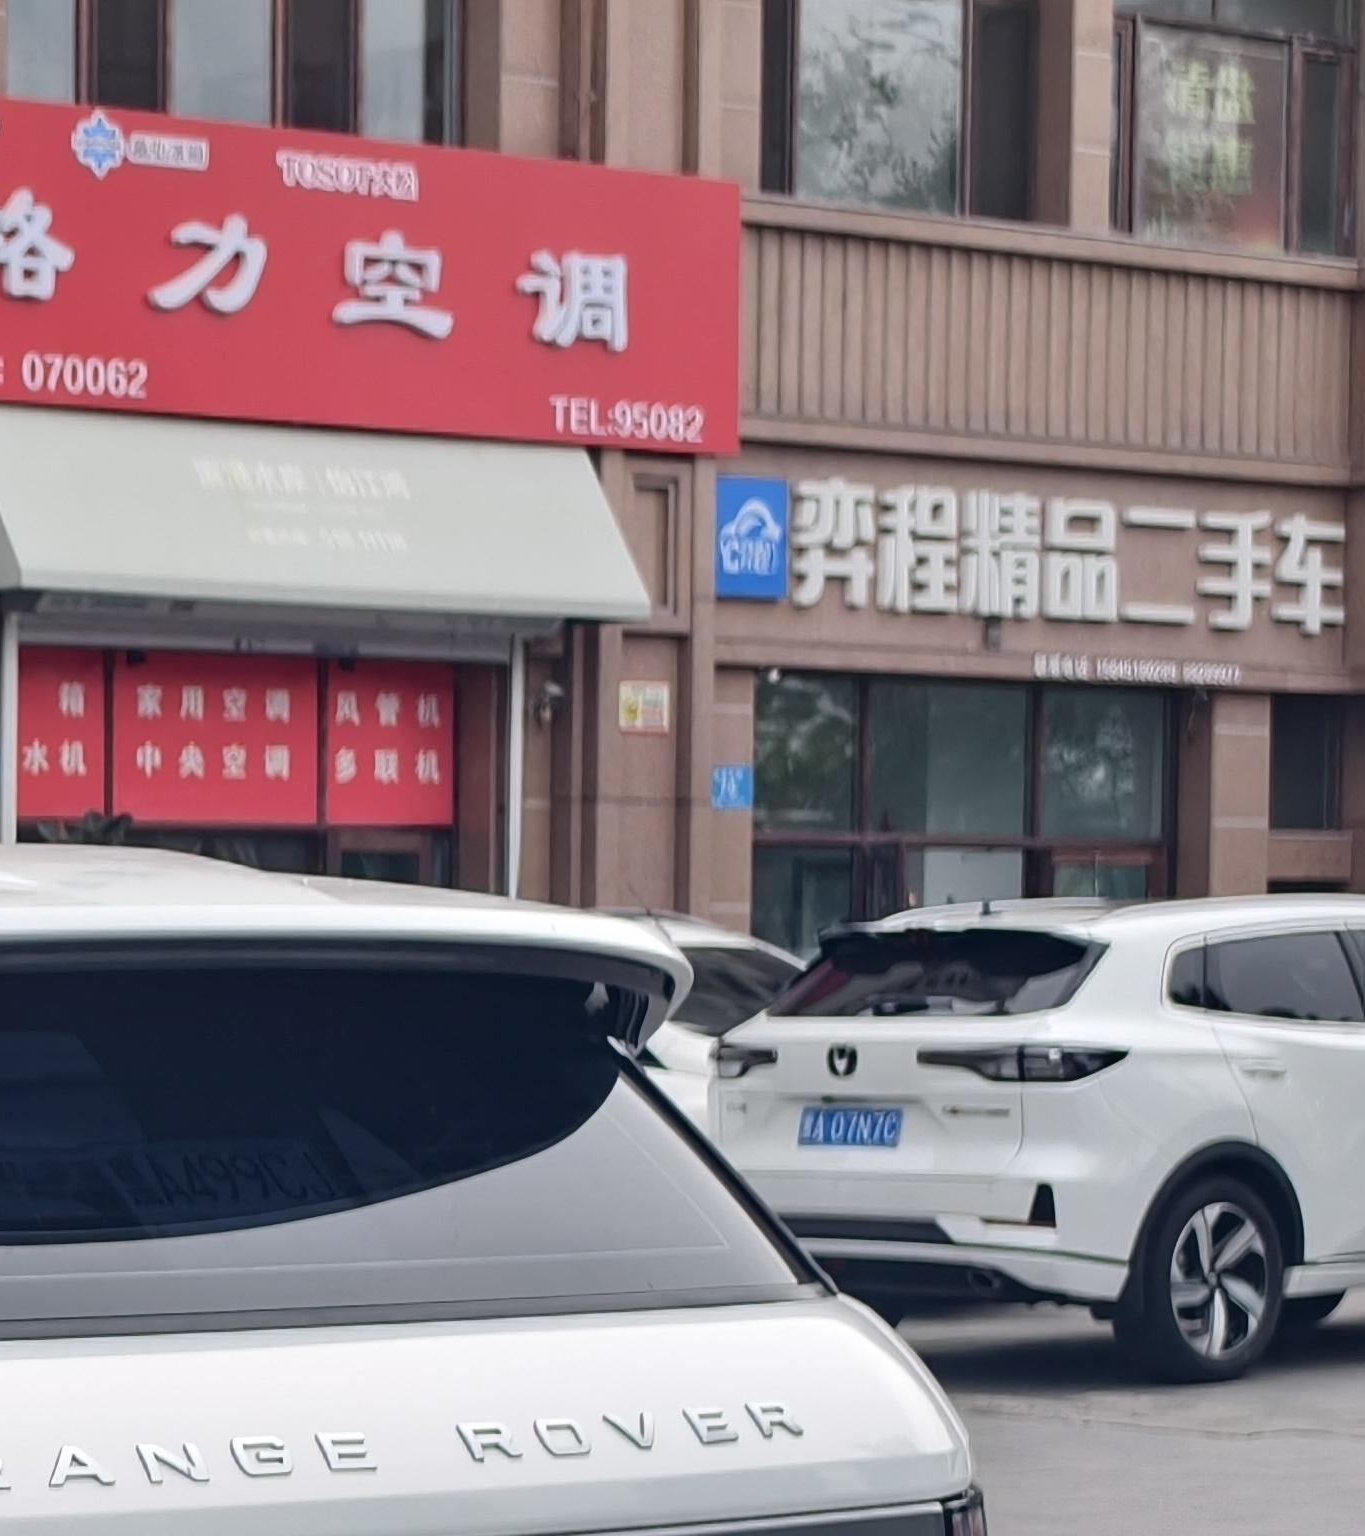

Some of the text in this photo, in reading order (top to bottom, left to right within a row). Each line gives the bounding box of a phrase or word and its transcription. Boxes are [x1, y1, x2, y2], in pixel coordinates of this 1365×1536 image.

[21, 351, 148, 399] 070062
[137, 740, 290, 782] 中央空调
[456, 1400, 804, 1460] ROVER
